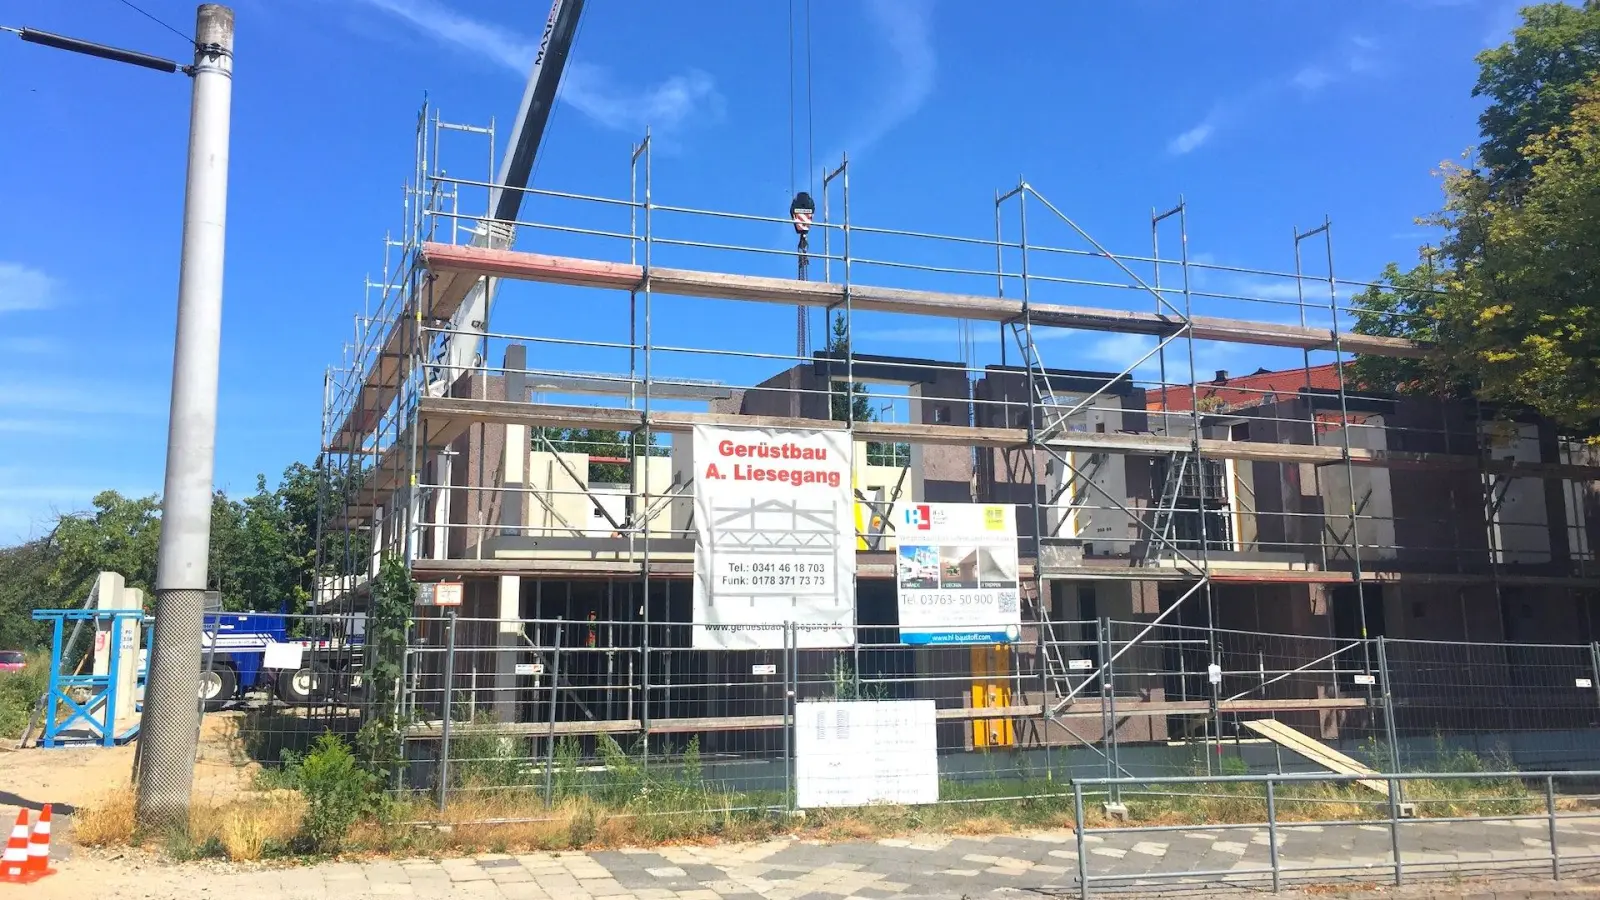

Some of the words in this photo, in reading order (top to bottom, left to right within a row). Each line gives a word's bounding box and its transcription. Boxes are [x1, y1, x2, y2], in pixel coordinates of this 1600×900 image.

[719, 440, 827, 460] Gerüstbau
[705, 462, 727, 480] A.
[733, 463, 841, 488] Liesegang
[728, 562, 749, 573] Tel.:
[752, 562, 776, 573] 0341
[778, 563, 791, 573] 46
[794, 563, 805, 573] 18
[807, 563, 825, 573] 703
[722, 575, 749, 586] Funk:
[752, 575, 776, 586] 0178
[778, 576, 796, 586] 371
[799, 576, 811, 586] 73
[814, 577, 825, 586] 73
[920, 594, 957, 605] 03763-
[959, 594, 972, 605] 50
[973, 594, 993, 605] 900
